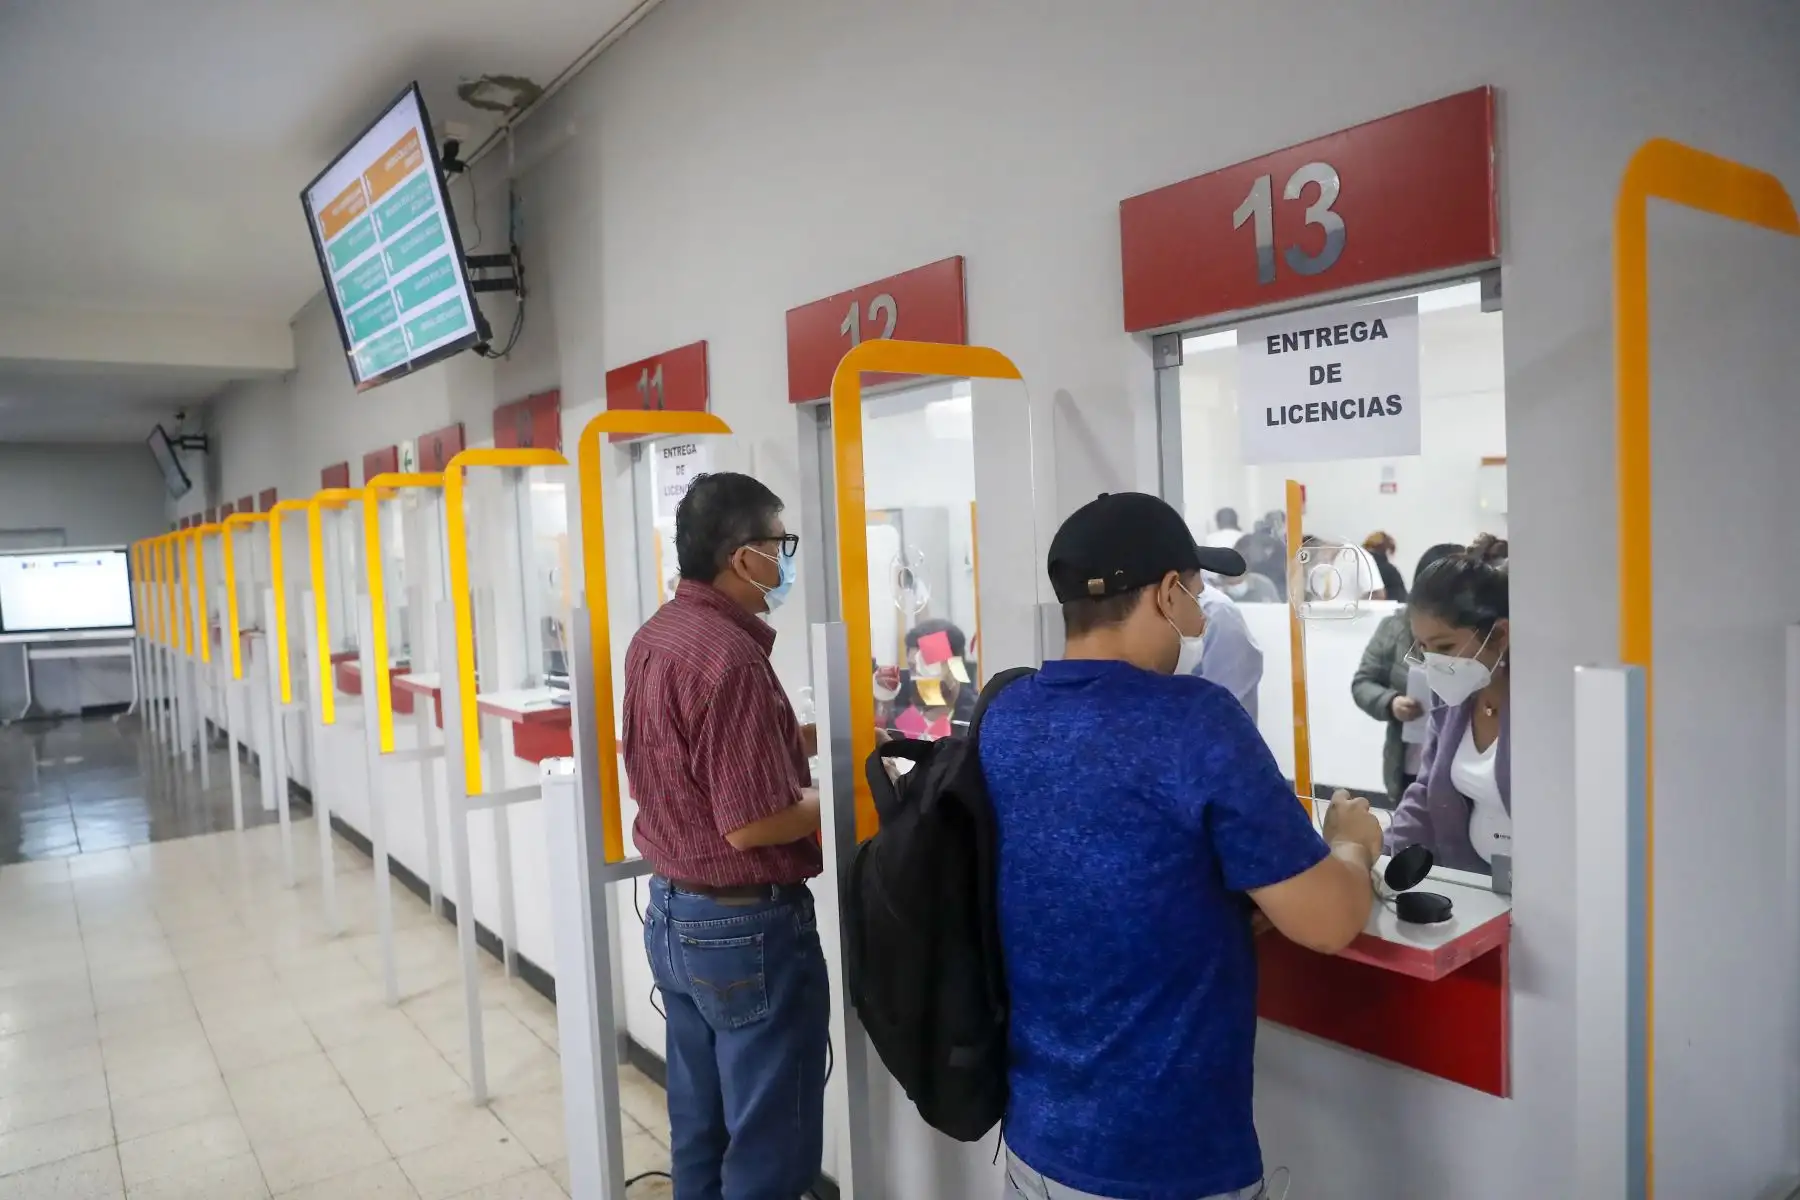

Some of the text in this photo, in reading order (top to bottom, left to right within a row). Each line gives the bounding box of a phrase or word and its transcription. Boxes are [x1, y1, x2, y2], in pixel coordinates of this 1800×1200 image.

[1232, 161, 1347, 285] 13
[840, 293, 898, 348] 12
[1266, 318, 1389, 355] ENTREGA
[636, 363, 665, 411] 11
[1309, 362, 1342, 386] DE
[1265, 394, 1403, 427] LICENCIAS
[663, 443, 697, 459] ENTREGA
[675, 464, 685, 476] DE
